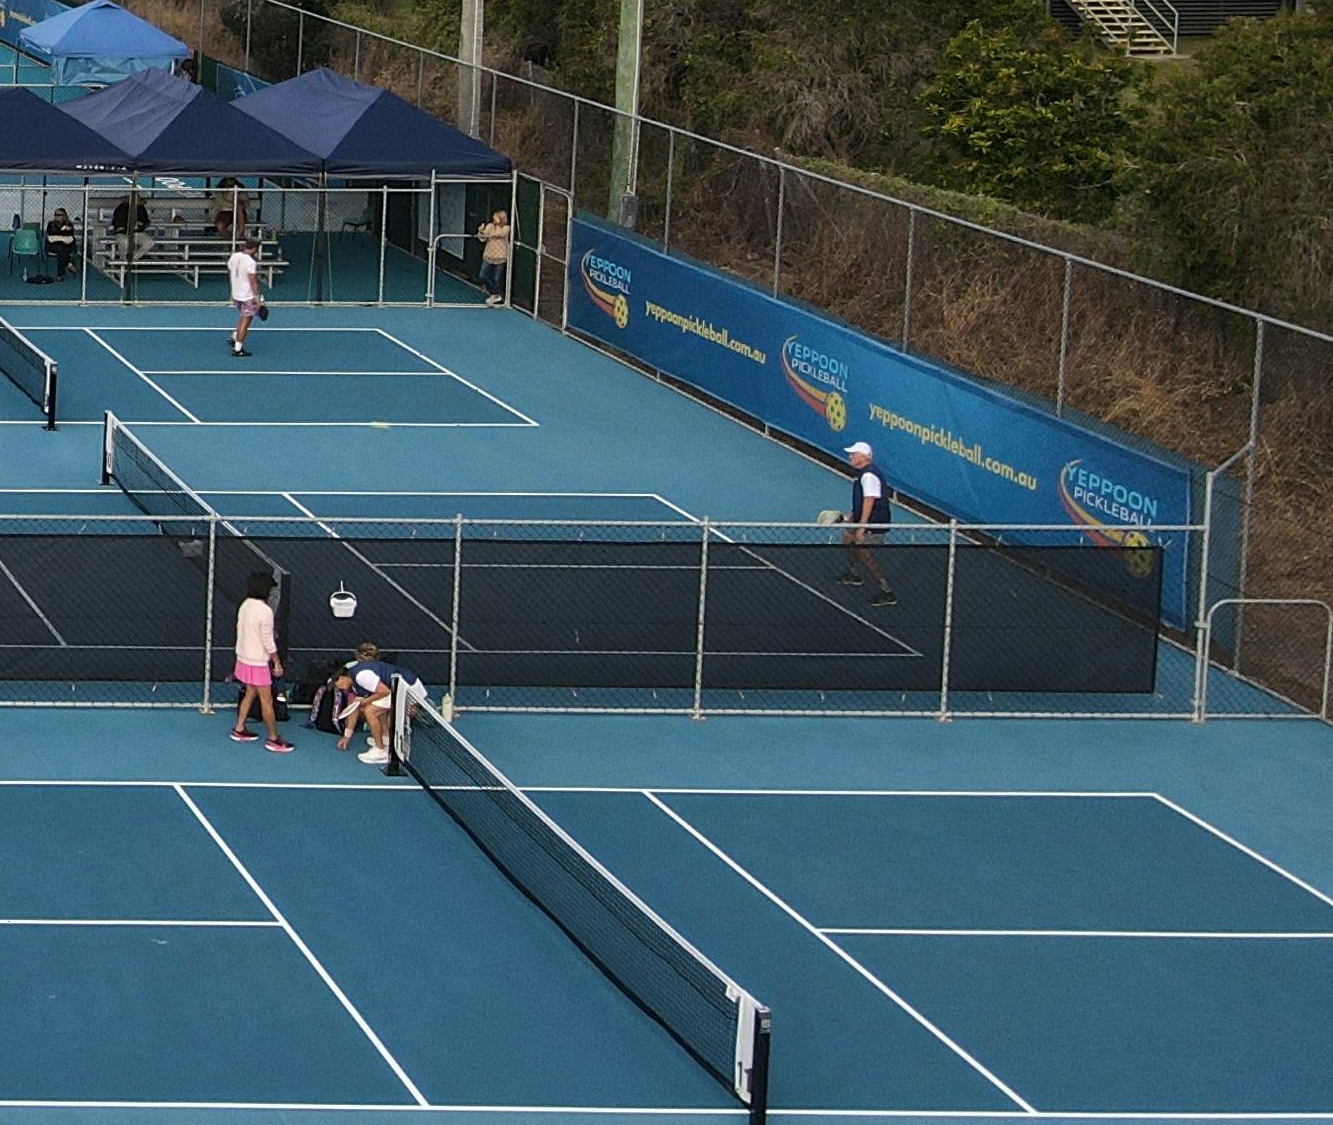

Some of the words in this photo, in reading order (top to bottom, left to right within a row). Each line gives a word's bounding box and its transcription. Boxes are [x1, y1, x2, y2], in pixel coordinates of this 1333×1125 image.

[585, 254, 631, 284] YEPPOON
[589, 268, 630, 295] PICKLEBALL
[645, 300, 767, 365] yeppoonpickleball.com.au
[787, 341, 849, 380] YEPPOON
[792, 358, 848, 393] PICKLEBALL
[869, 403, 1038, 491] yeppoonpickleball.com.au
[1065, 462, 1158, 518] YEPPOON
